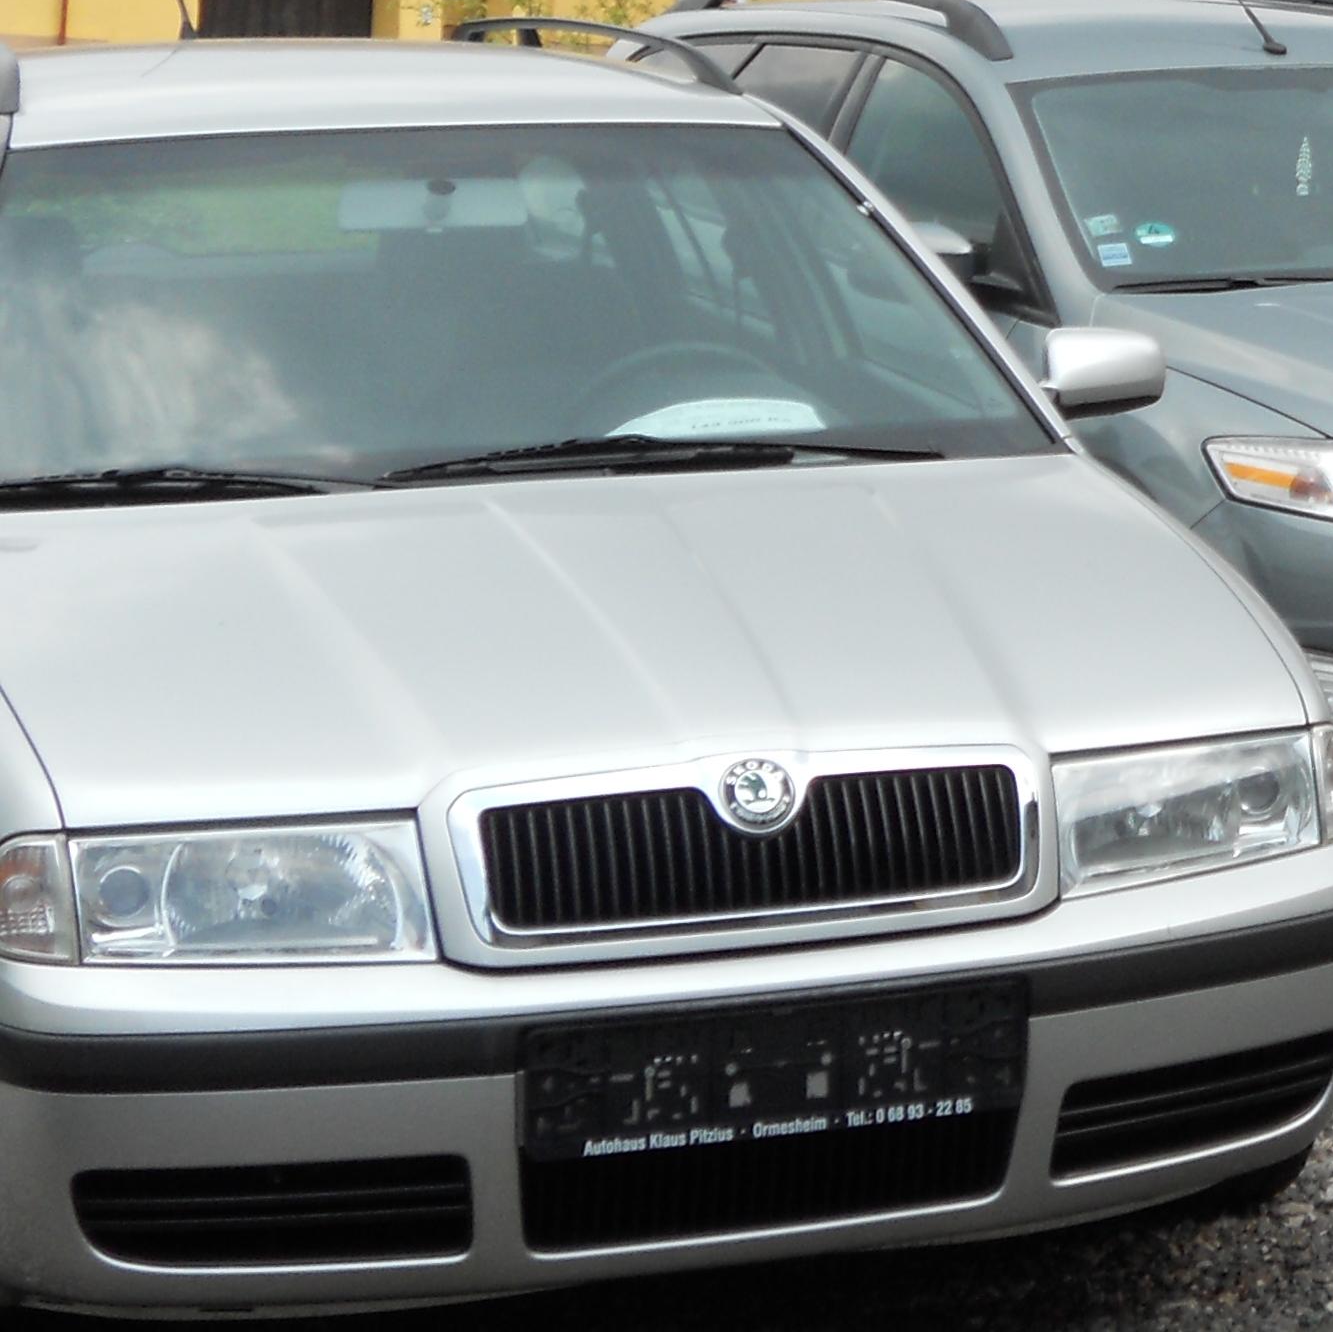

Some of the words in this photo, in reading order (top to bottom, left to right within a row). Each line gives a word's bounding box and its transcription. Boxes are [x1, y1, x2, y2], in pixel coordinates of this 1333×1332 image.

[583, 1135, 647, 1157] Autohaus
[649, 1130, 687, 1149] Klaus
[689, 1126, 734, 1146] Pitzius
[752, 1116, 828, 1139] Ormesheim
[935, 1099, 952, 1118] 22
